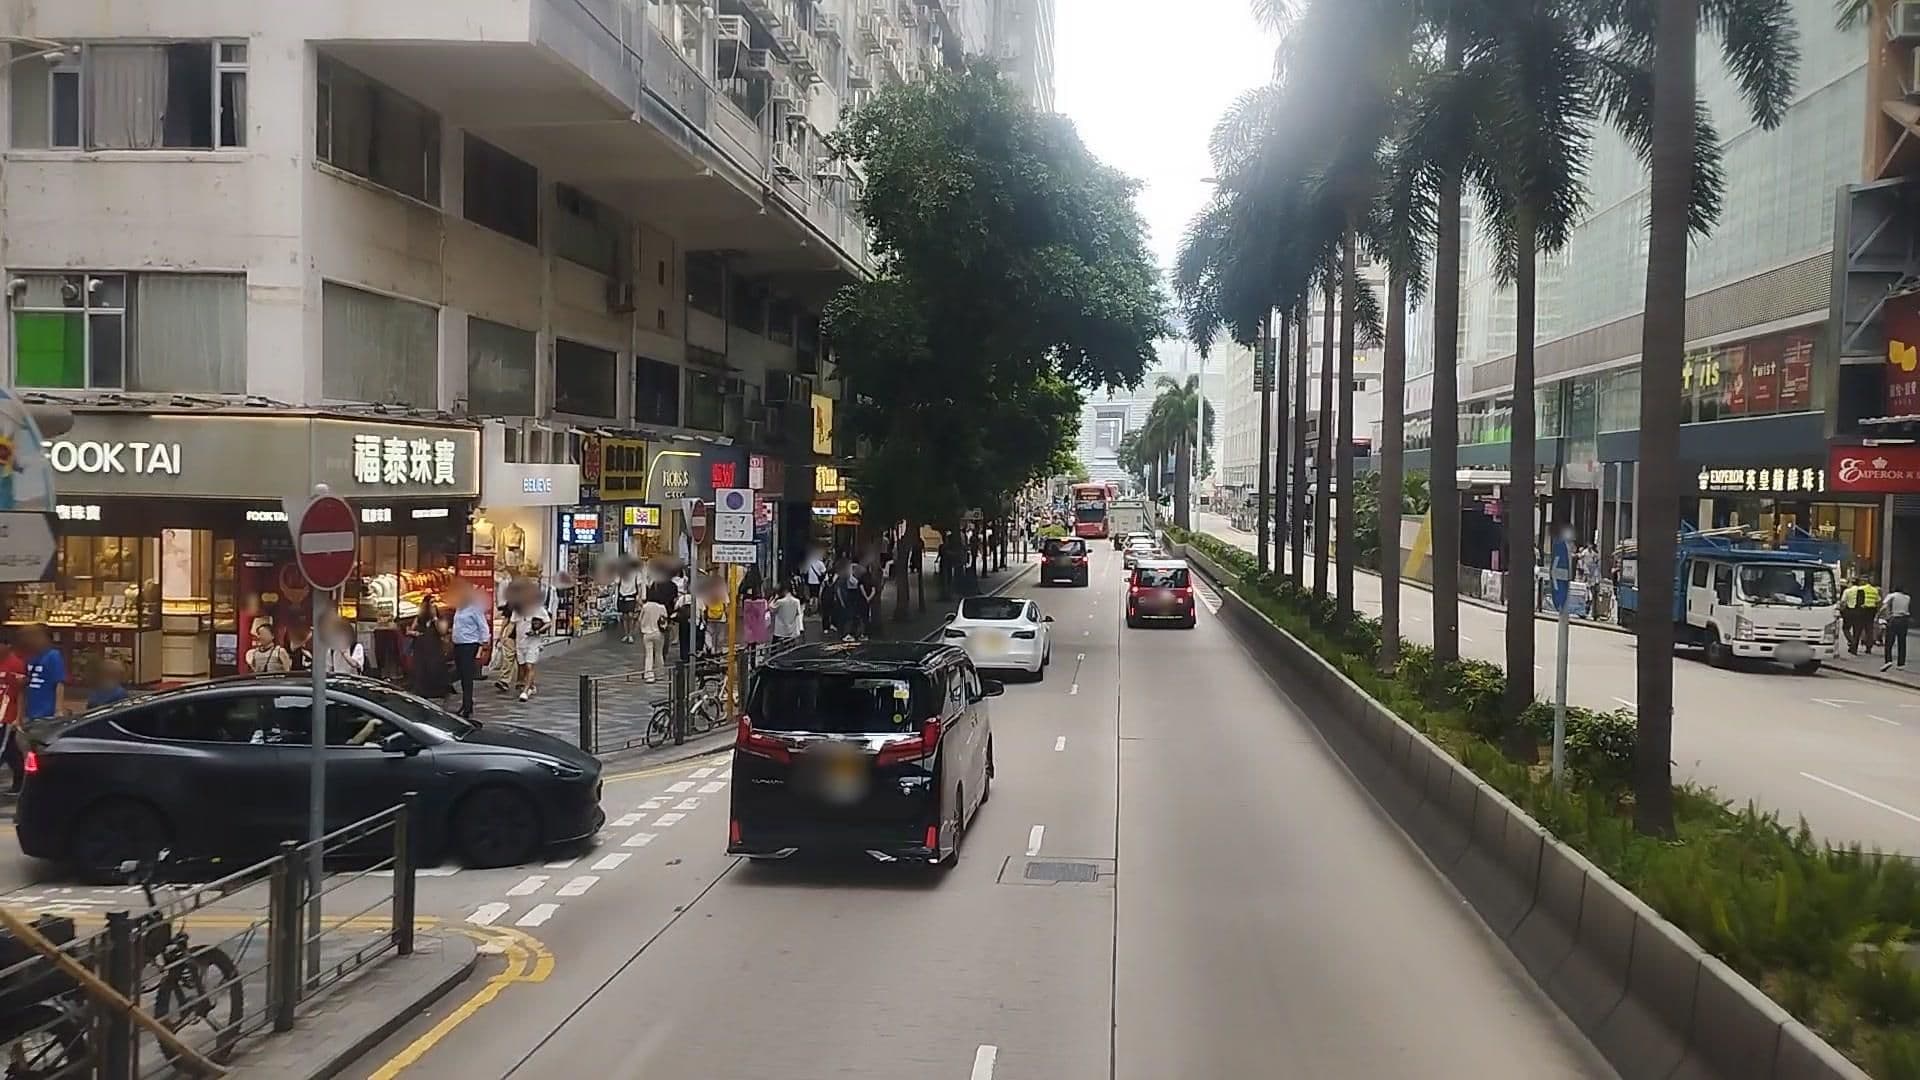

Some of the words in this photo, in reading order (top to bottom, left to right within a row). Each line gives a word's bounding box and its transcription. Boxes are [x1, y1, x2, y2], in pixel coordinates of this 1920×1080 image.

[1752, 360, 1776, 378] twist
[129, 442, 182, 474] TAI
[353, 434, 456, 485] 福泰珠寶
[1711, 469, 1744, 484] EMPEROR
[1839, 457, 1904, 484] EMPEROR
[523, 477, 552, 493] BELIEVE
